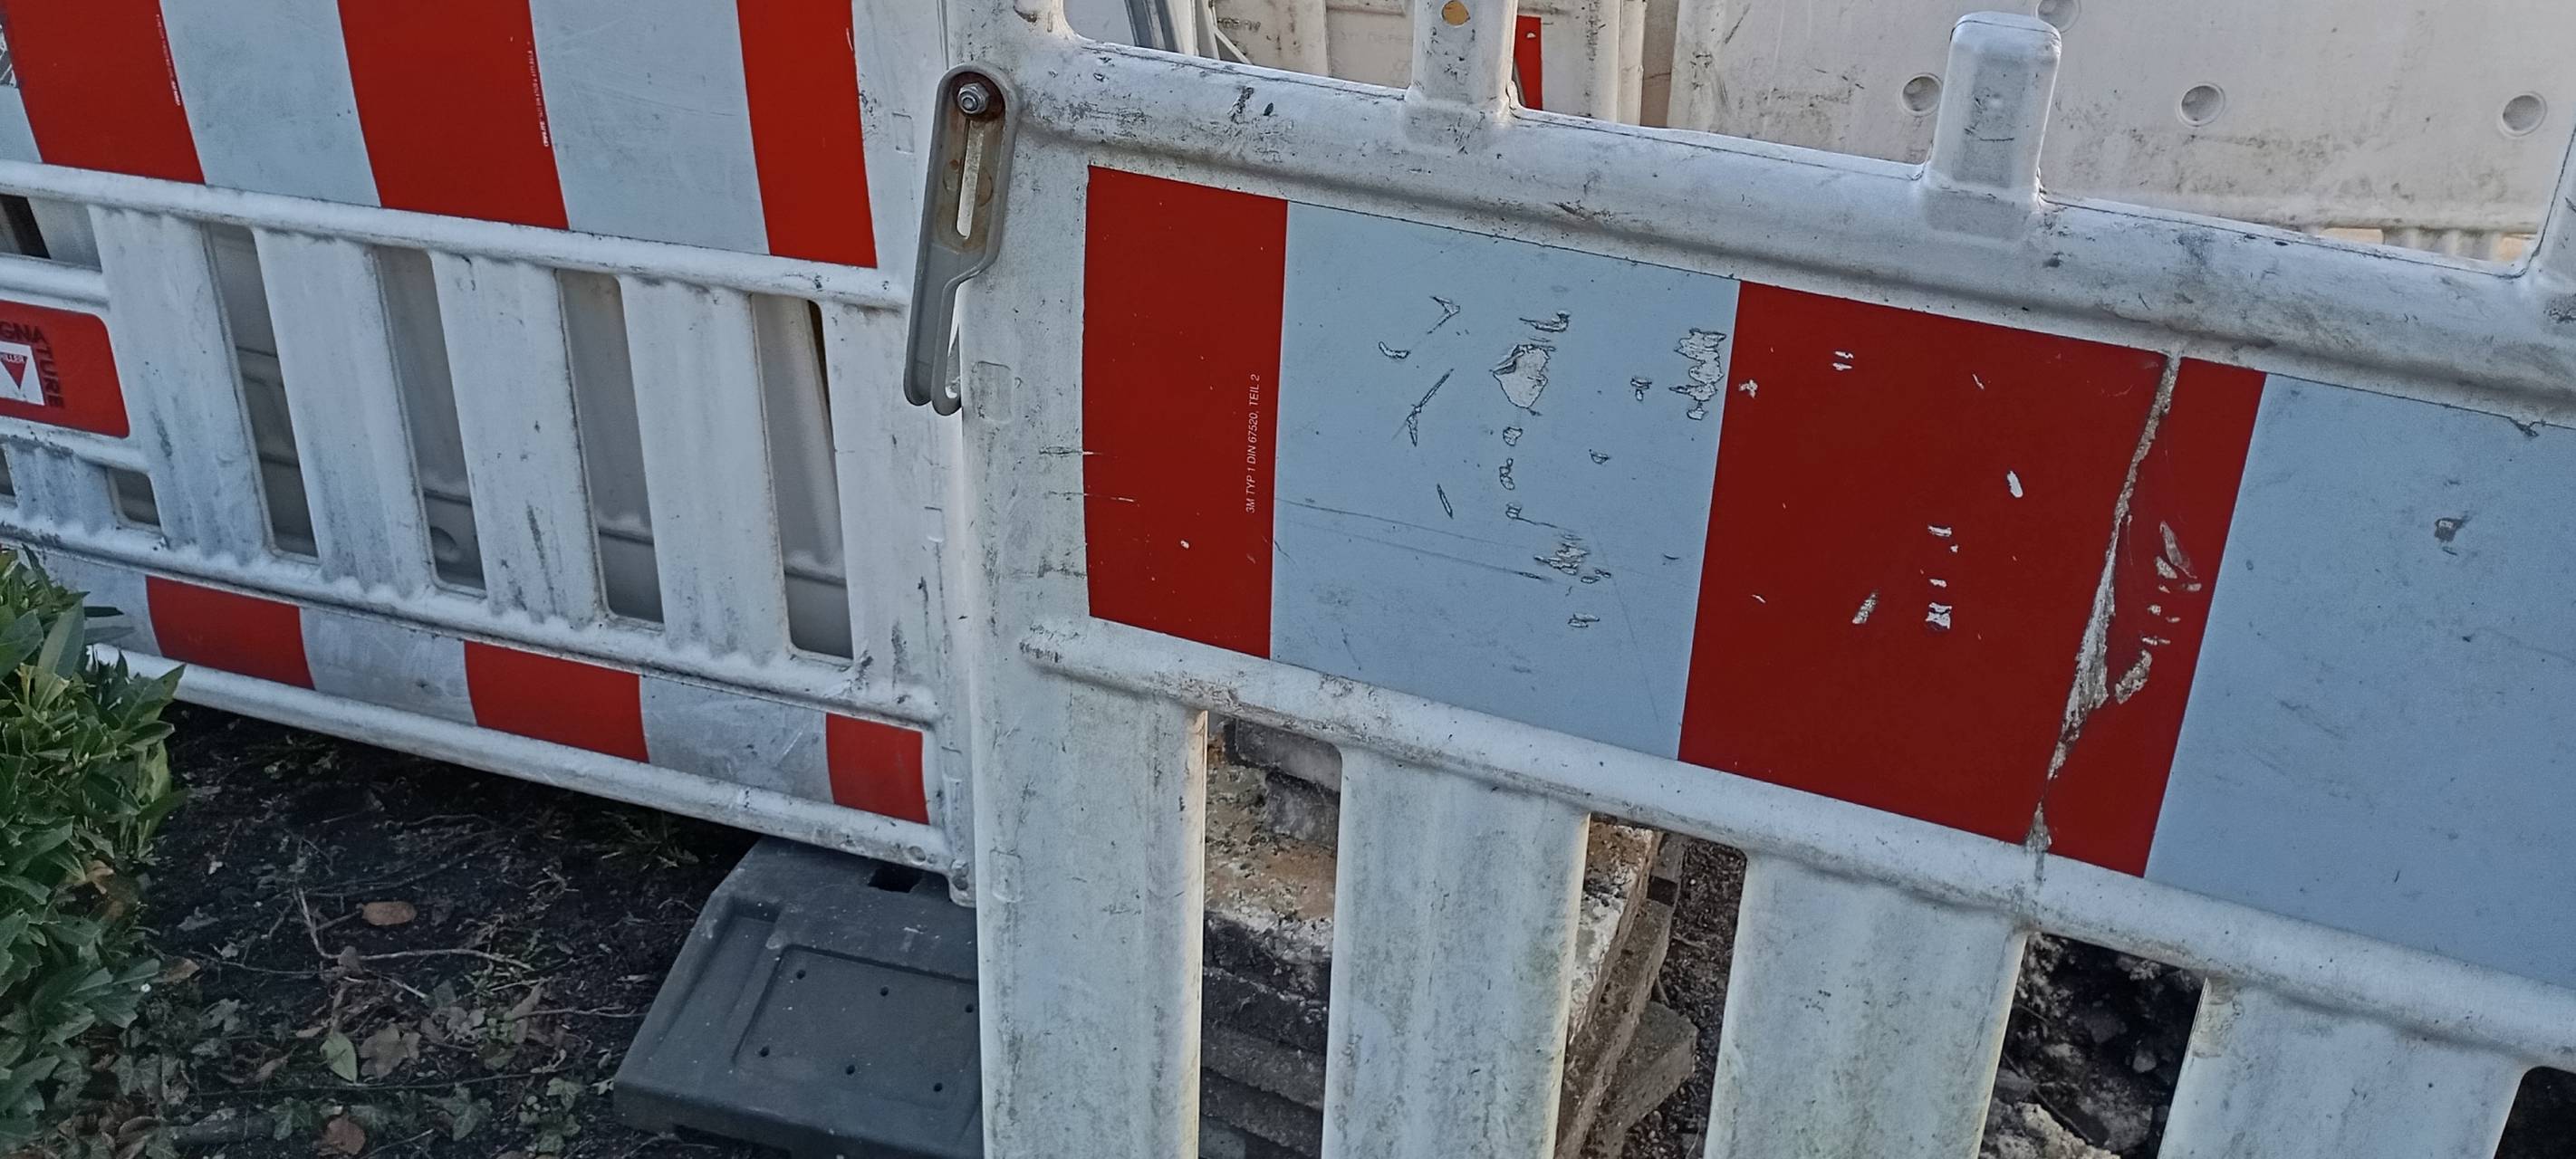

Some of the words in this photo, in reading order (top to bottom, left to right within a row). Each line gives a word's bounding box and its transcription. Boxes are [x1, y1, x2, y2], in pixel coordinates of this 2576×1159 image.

[1250, 373, 1261, 381] 2
[1249, 383, 1260, 407] TEIL
[1247, 410, 1260, 444] 67520,
[1246, 445, 1257, 465] DIN
[1245, 475, 1256, 494] TYP
[1245, 498, 1255, 513] 3M
